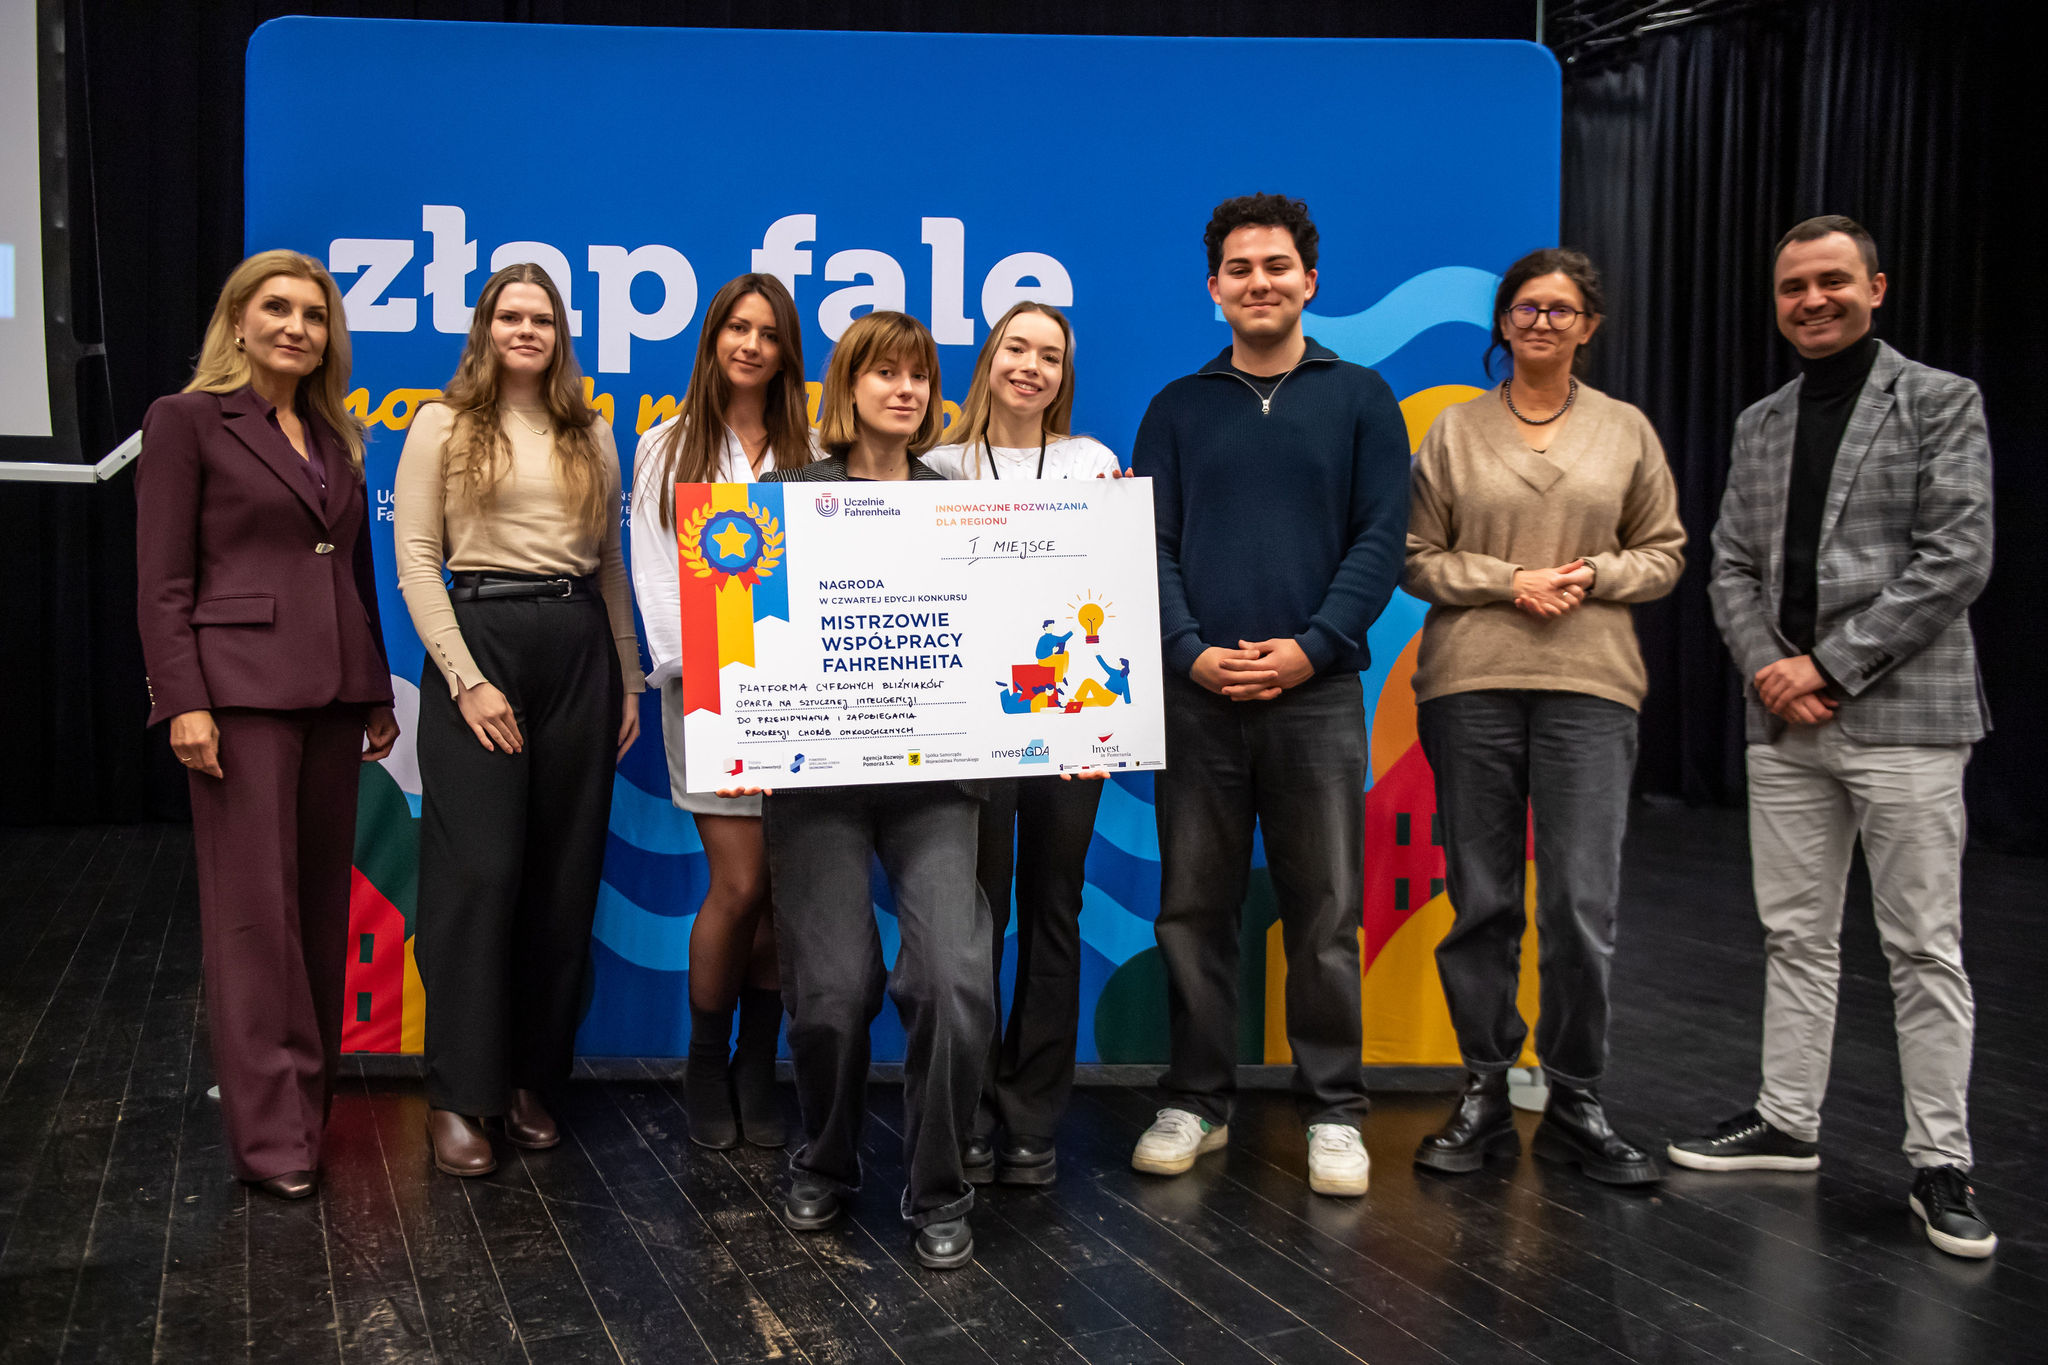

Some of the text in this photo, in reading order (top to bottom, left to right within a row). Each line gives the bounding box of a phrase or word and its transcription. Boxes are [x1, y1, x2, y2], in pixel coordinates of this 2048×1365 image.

[843, 497, 885, 507] Uczelnie
[935, 501, 1089, 513] INNOWACYJNE ROZWIĄZANIA
[844, 507, 901, 517] Fahrenheita
[936, 517, 1008, 527] DLA REGIONU
[993, 540, 1056, 560] MIEJSCE
[819, 579, 885, 590] NAGRODA
[819, 593, 968, 605] W CZWARTEJ EDYCJI KONKURSU
[820, 612, 950, 630] MISTRZOWIE
[821, 631, 963, 652] WSPÓŁPRACY
[822, 654, 963, 673] FAHRENHEITA
[739, 683, 808, 693] PLATFORMA
[736, 700, 773, 708] OPARTA
[779, 699, 792, 707] NA
[737, 716, 751, 725] DO
[1091, 744, 1120, 754] Invest
[862, 755, 882, 763] Agencja
